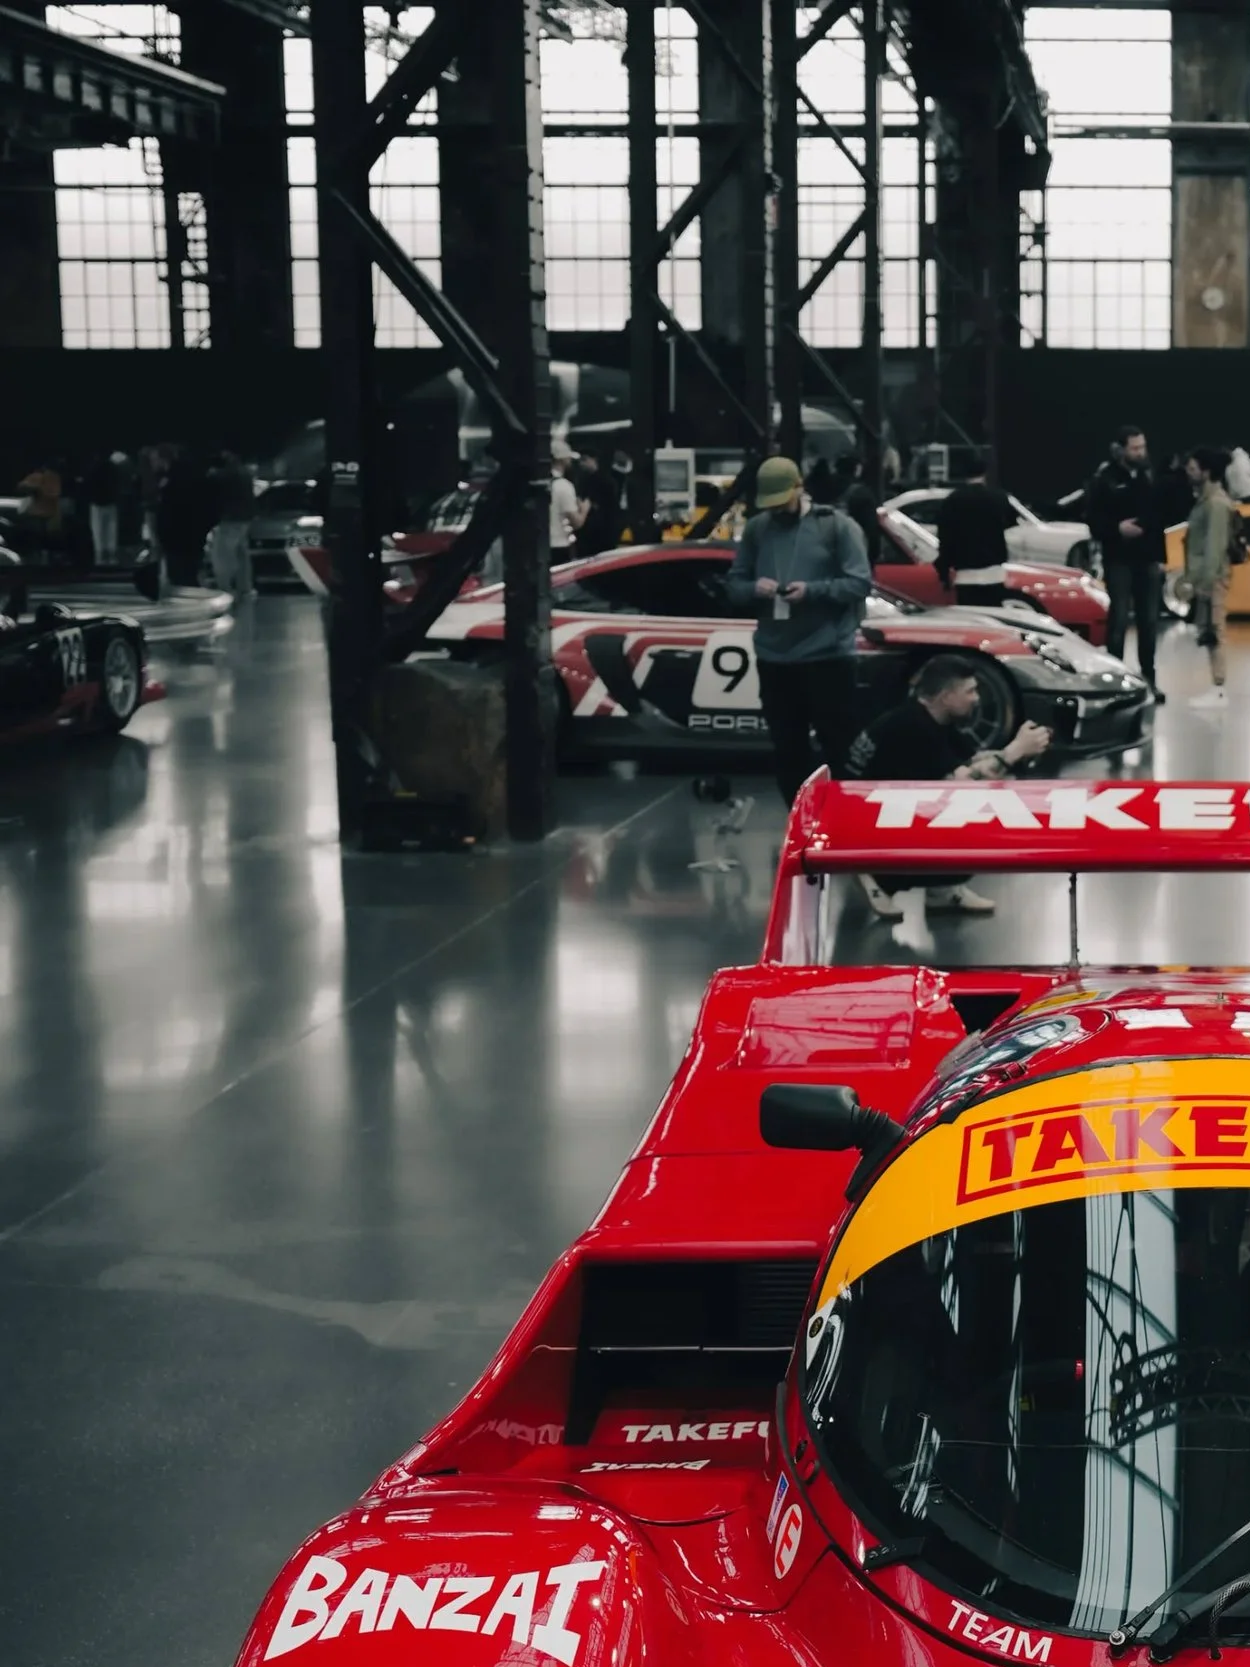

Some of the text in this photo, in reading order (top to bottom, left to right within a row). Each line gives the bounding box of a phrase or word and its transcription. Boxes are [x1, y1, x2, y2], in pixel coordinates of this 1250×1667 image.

[712, 646, 750, 693] 9
[263, 1555, 610, 1667] BANZAI
[947, 1601, 1053, 1663] TEAM
